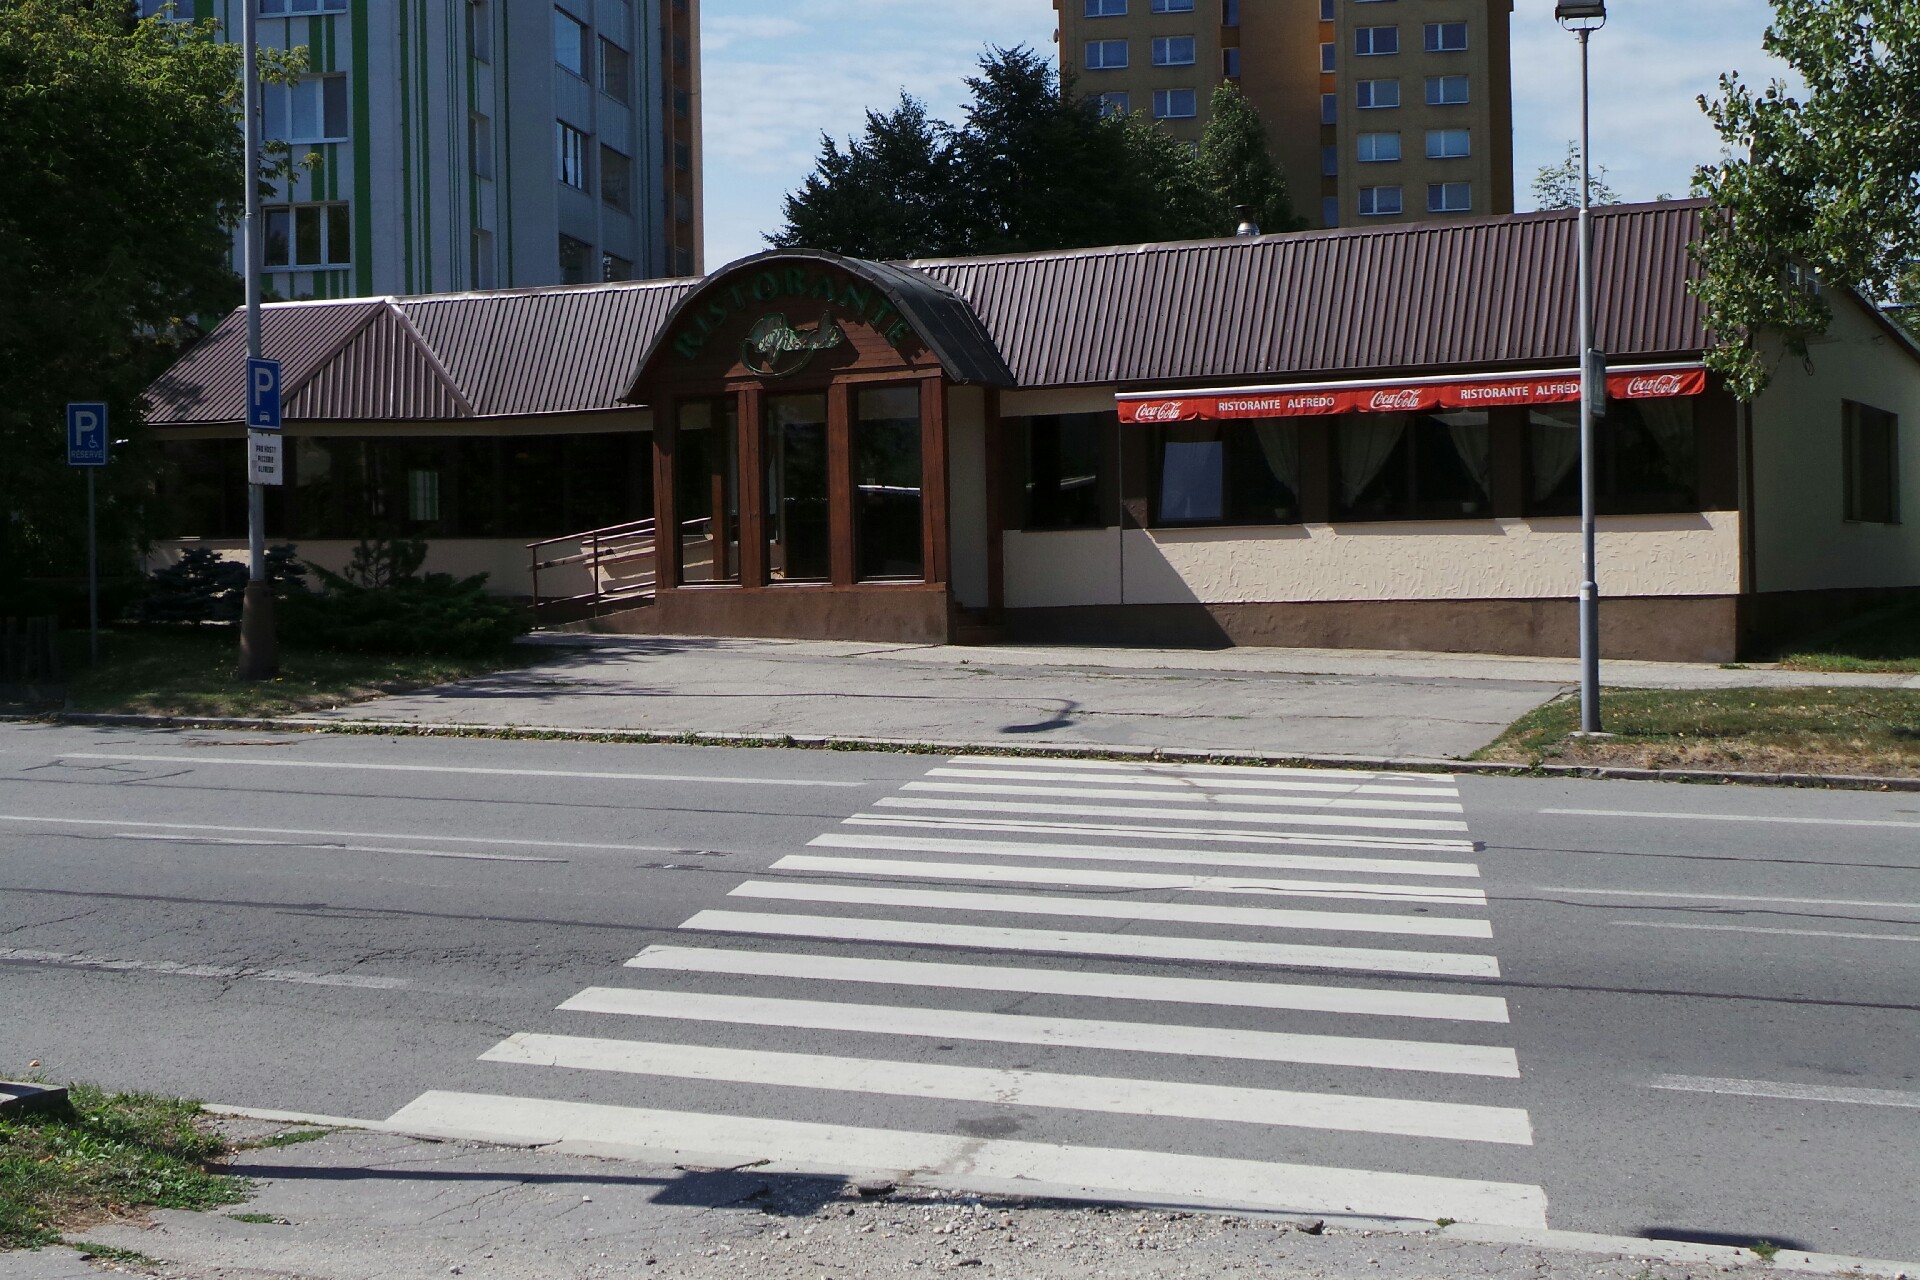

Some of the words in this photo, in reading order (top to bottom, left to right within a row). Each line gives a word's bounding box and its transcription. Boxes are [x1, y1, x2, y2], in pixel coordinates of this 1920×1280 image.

[673, 267, 912, 360] RISTORANTE
[255, 367, 274, 406] P
[1460, 386, 1529, 400] RISTORANTE
[1535, 381, 1582, 396] ALFRÉD
[1627, 374, 1684, 395] Coca-Cola
[1218, 399, 1281, 412] RISTORANTE
[1370, 389, 1422, 409] Coca-Cola
[1135, 401, 1183, 420] Coca-Cola
[75, 410, 98, 446] P
